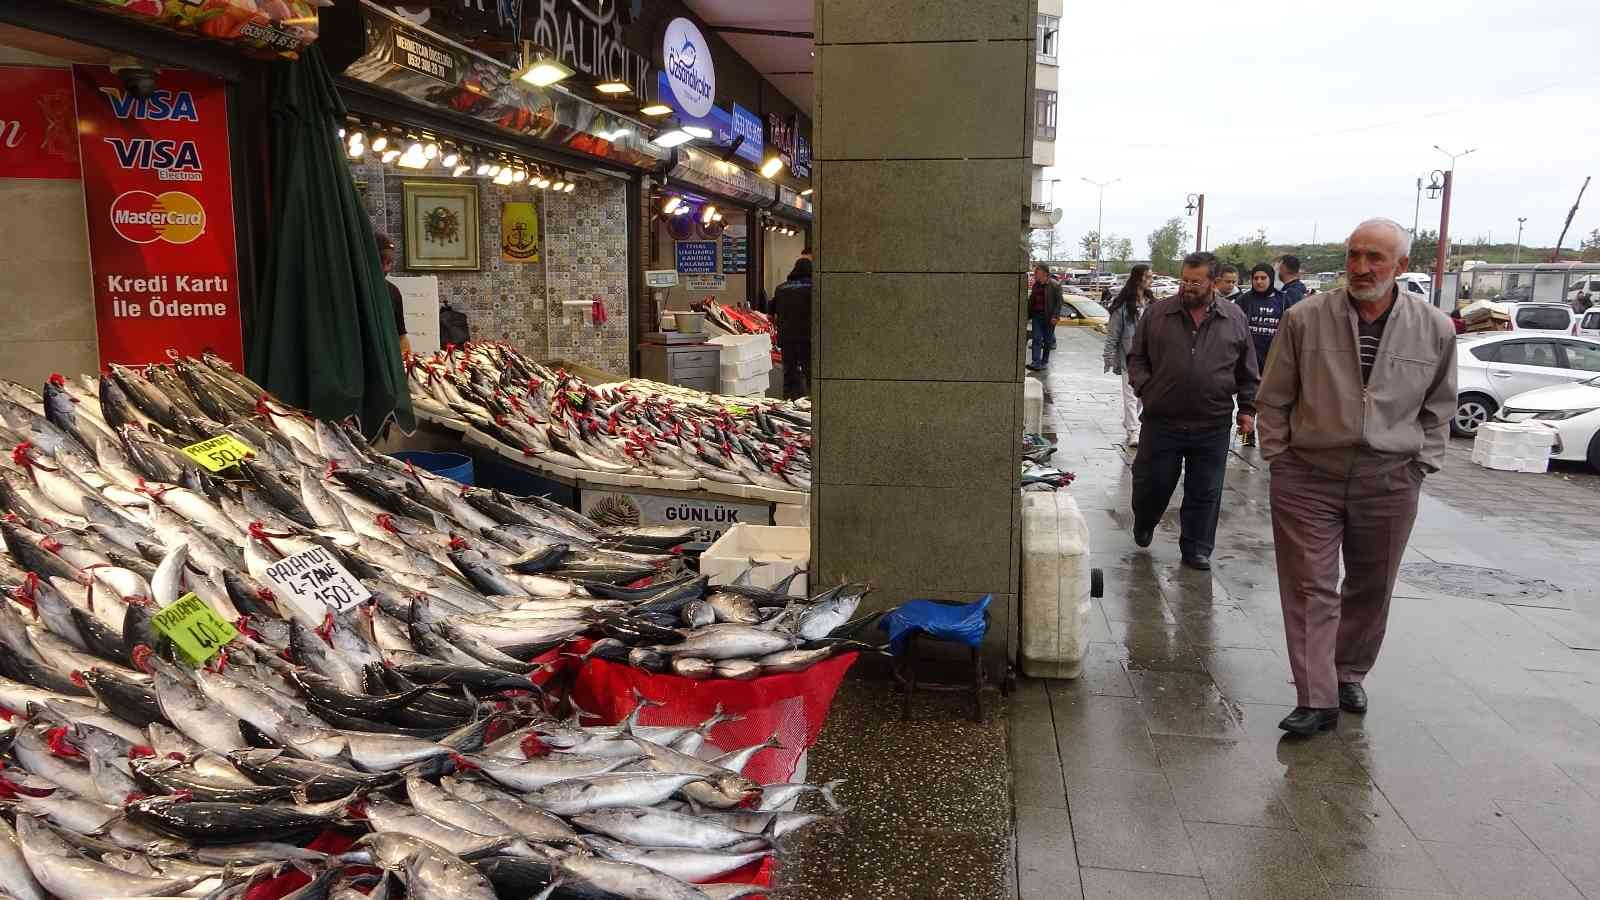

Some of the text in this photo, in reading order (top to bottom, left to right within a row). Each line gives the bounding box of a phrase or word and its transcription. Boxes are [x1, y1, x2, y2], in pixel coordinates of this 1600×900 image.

[100, 86, 199, 121] VISA
[104, 137, 202, 170] VISA
[159, 169, 202, 181] Electron
[115, 209, 202, 225] MasterCard
[107, 275, 228, 292] Kredi Kartı
[113, 296, 227, 317] İle Ödeme
[665, 503, 739, 523] GÜNLÜK
[266, 546, 331, 584] PALAMUT
